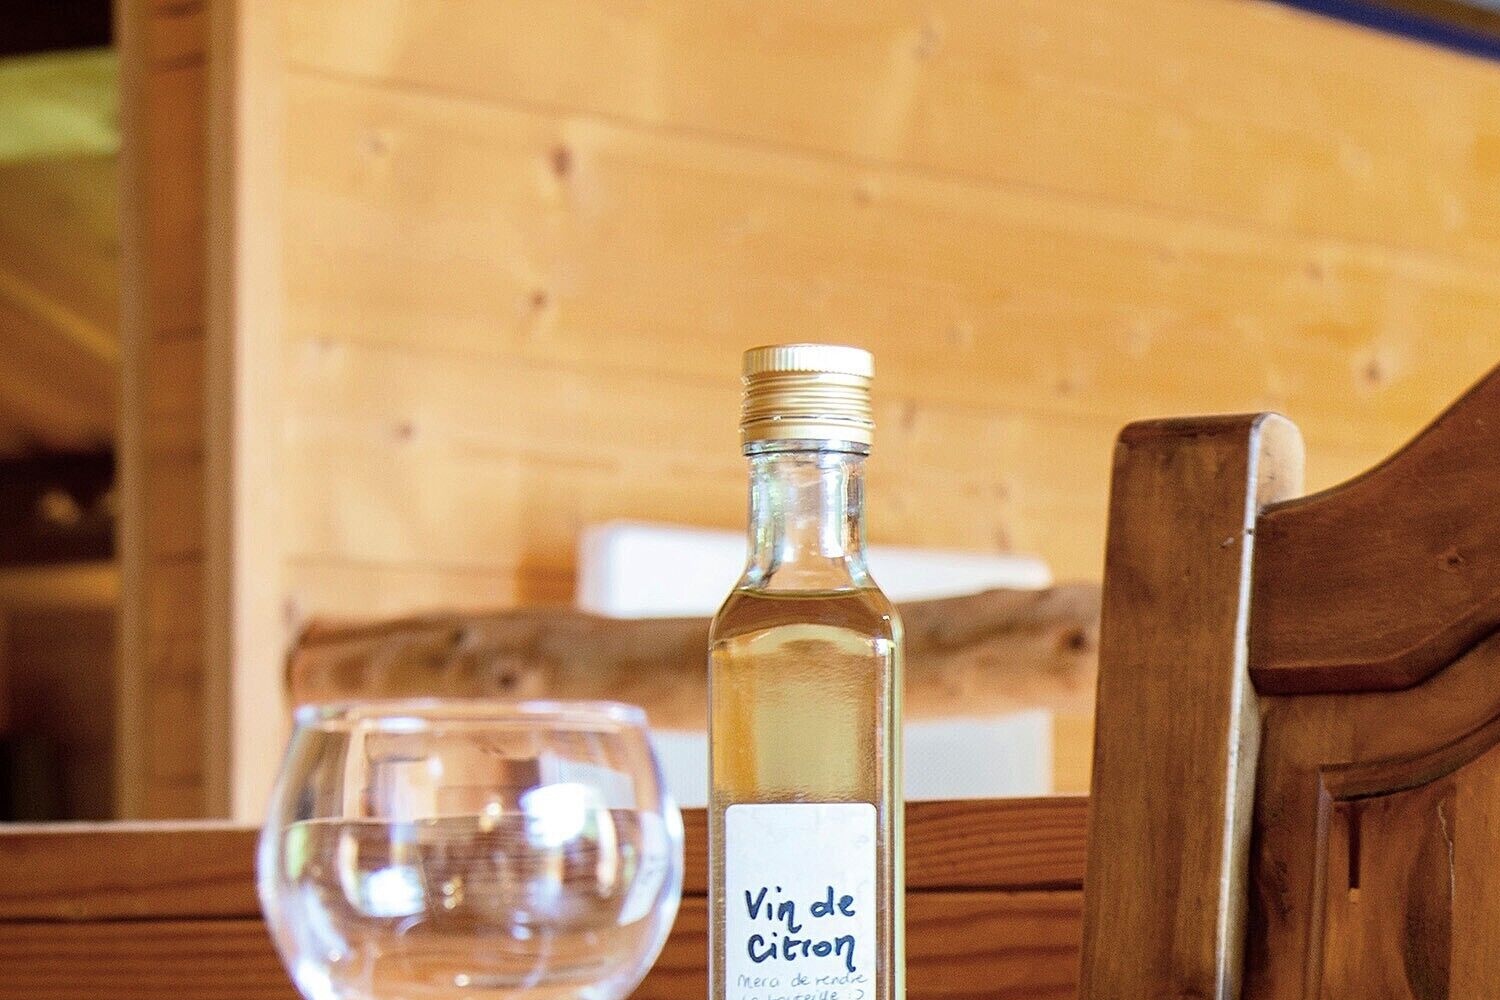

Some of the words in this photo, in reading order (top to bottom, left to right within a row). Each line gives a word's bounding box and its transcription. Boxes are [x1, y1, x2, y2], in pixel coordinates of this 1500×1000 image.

[745, 886, 802, 933] Vin
[810, 886, 856, 918] de
[791, 972, 810, 987] de
[816, 973, 868, 985] rendre
